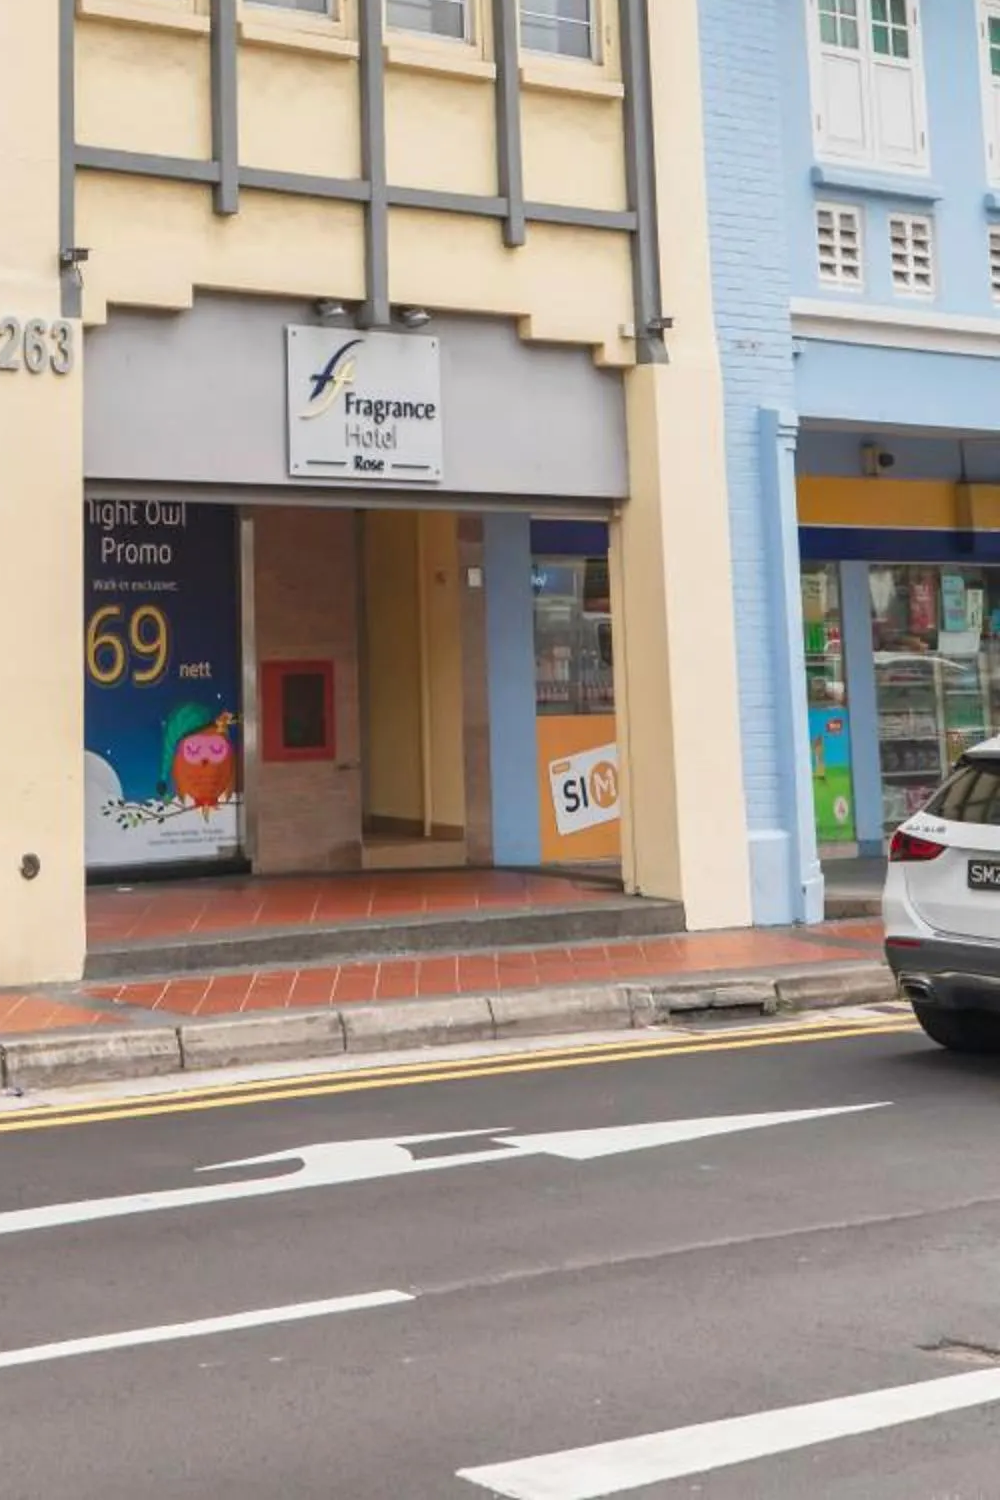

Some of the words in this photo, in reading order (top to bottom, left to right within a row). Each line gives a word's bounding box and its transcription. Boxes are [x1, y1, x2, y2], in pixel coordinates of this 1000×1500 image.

[345, 392, 436, 425] Fragrance
[345, 423, 398, 449] Hotel
[353, 455, 385, 472] Rose
[145, 499, 187, 527] Owl
[101, 537, 172, 564] Promo
[86, 604, 168, 683] 69
[179, 661, 213, 678] nett
[563, 766, 617, 813] SIM
